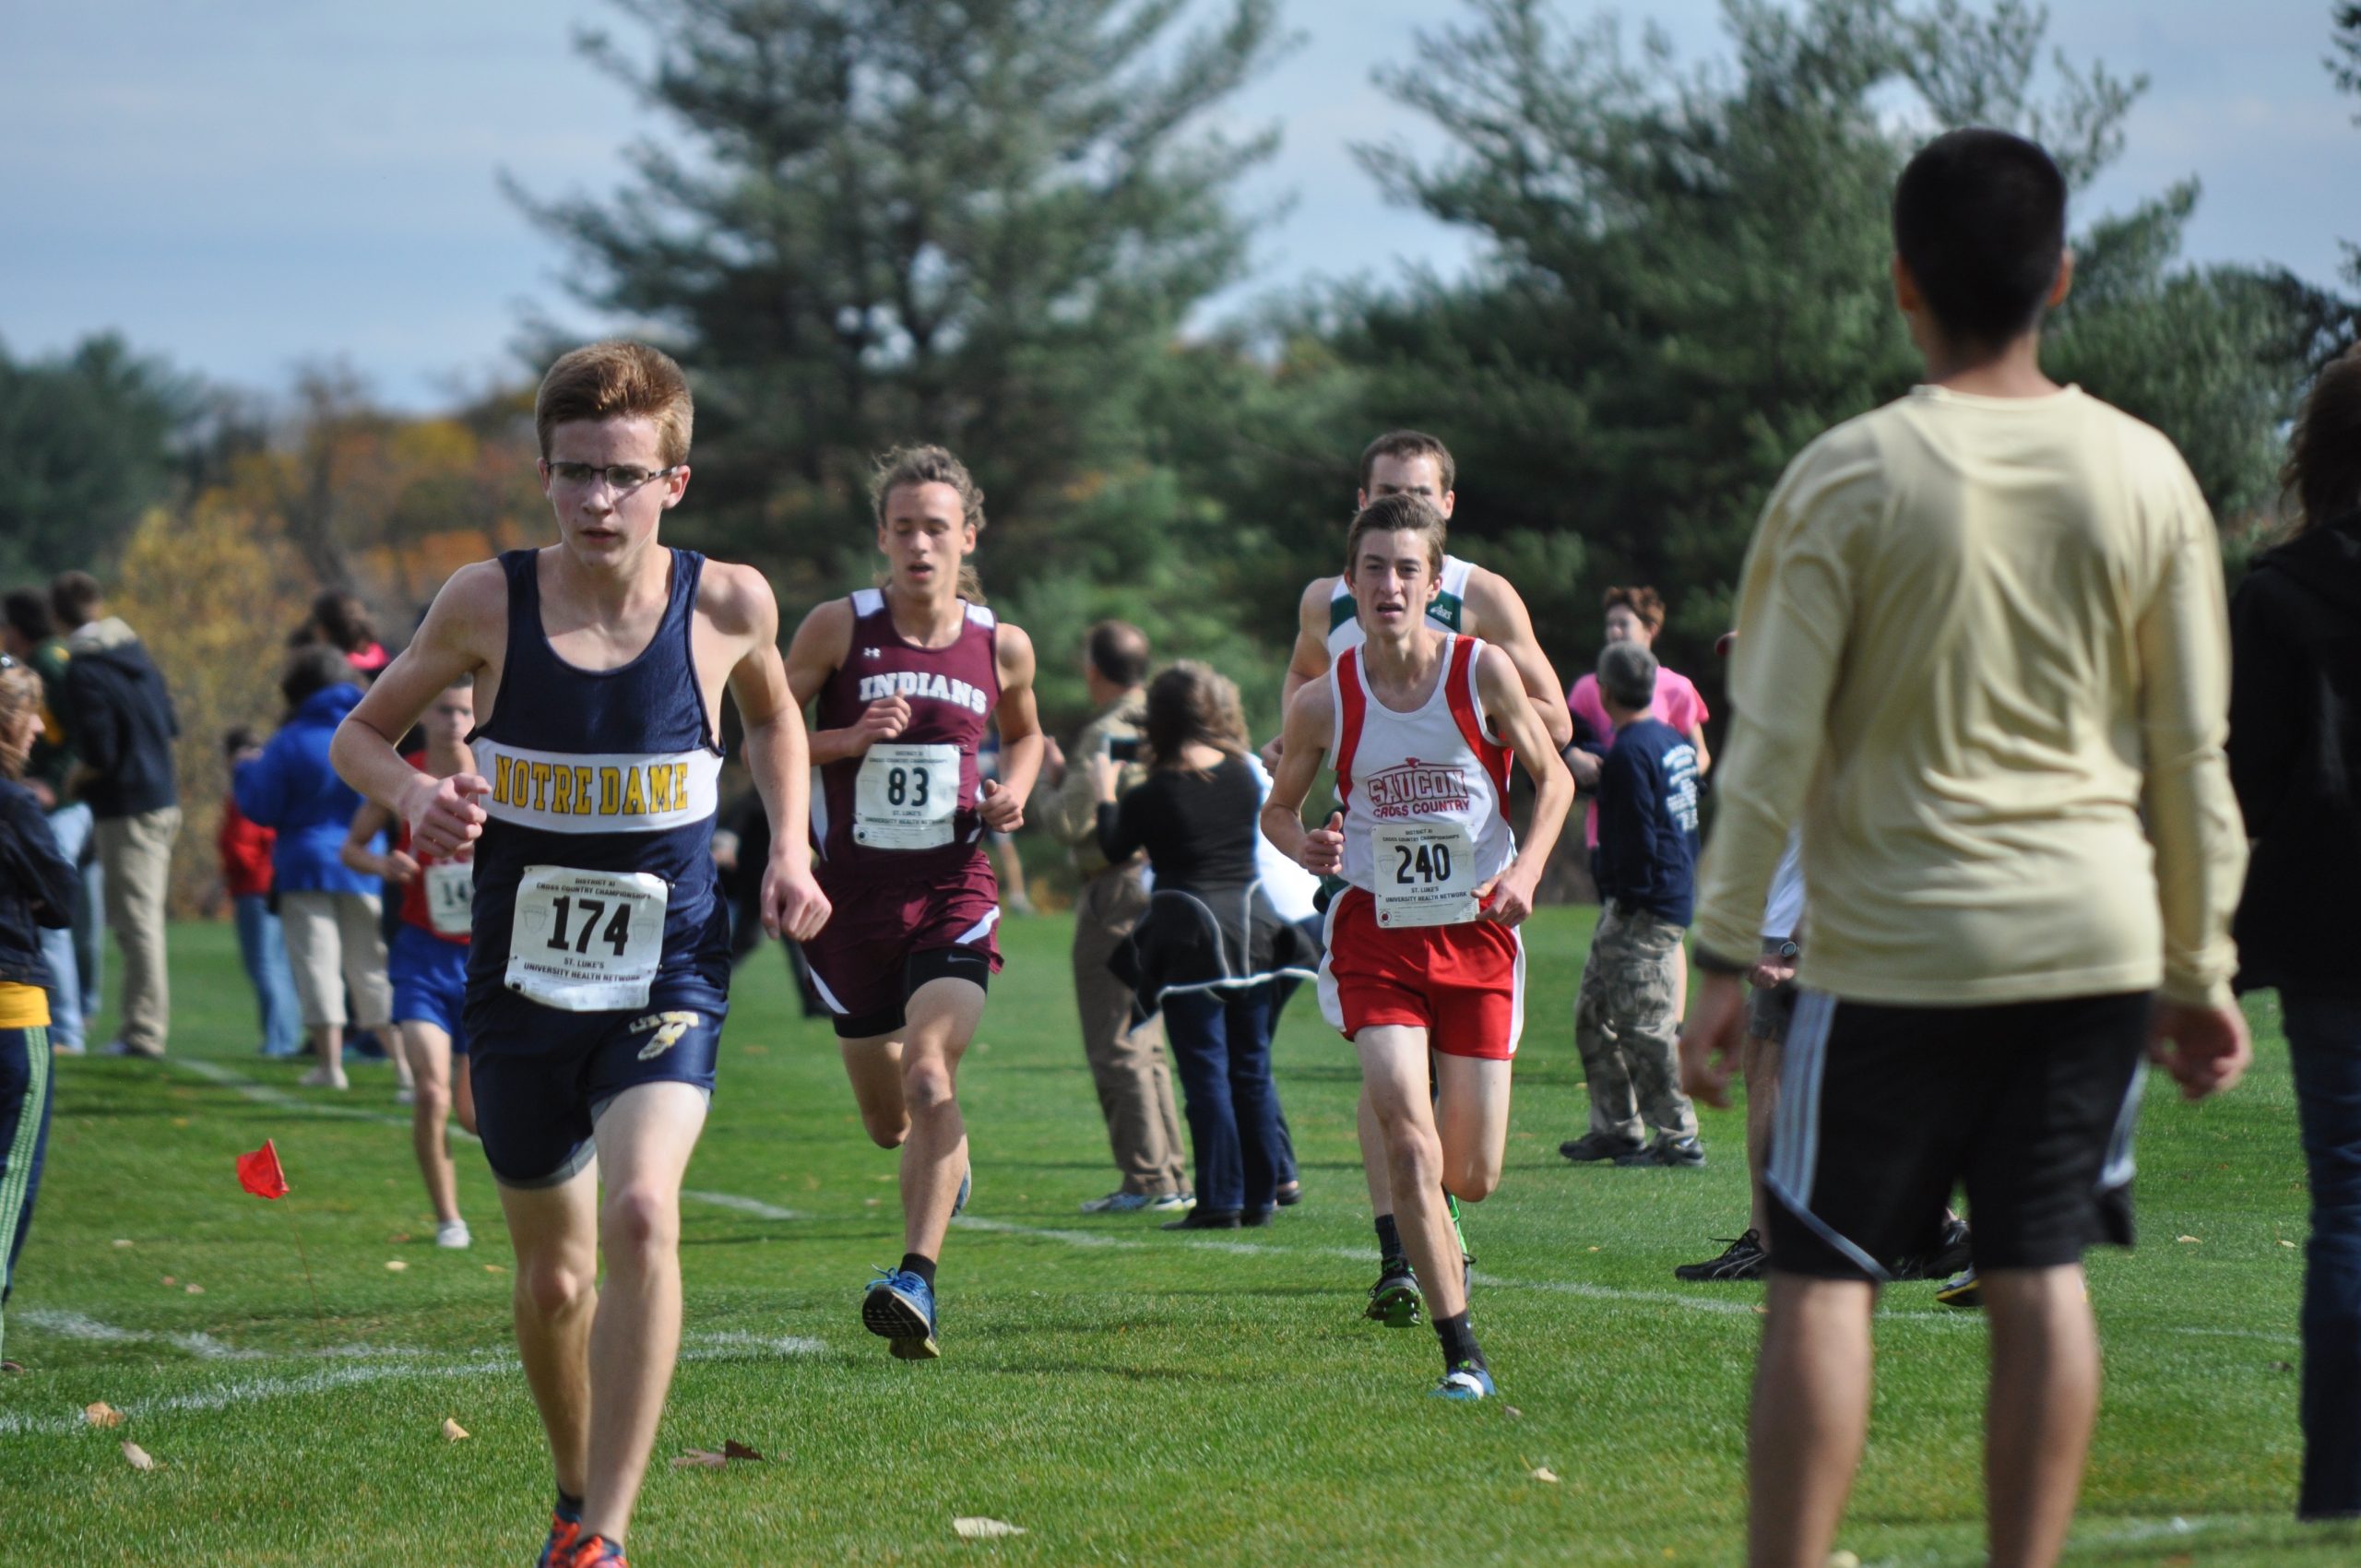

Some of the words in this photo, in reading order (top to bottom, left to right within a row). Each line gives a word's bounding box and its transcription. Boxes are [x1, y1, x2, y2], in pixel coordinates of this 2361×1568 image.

[859, 671, 987, 716] INDIANS
[492, 753, 593, 815] NOTRE
[599, 762, 689, 815] DAME
[887, 766, 930, 807] 83
[1367, 768, 1470, 807] SAUCON
[1372, 804, 1410, 818] CROSS
[1412, 799, 1471, 814] COUNTRY
[1394, 843, 1452, 885] 240
[536, 882, 560, 891] CROSS
[561, 885, 594, 894] COUNTRY
[594, 887, 652, 900] CHAMPIONSHIPS
[575, 877, 607, 886] DISTRICT
[1418, 894, 1439, 902] HEALTH
[1440, 891, 1467, 900] NETWORK
[547, 896, 633, 956] 174
[524, 962, 570, 978] UNIVERSITY
[571, 970, 601, 981] HEALTH
[602, 973, 641, 982] NETWORK
[564, 956, 575, 967] ST.
[576, 959, 605, 969] LUKE'S
